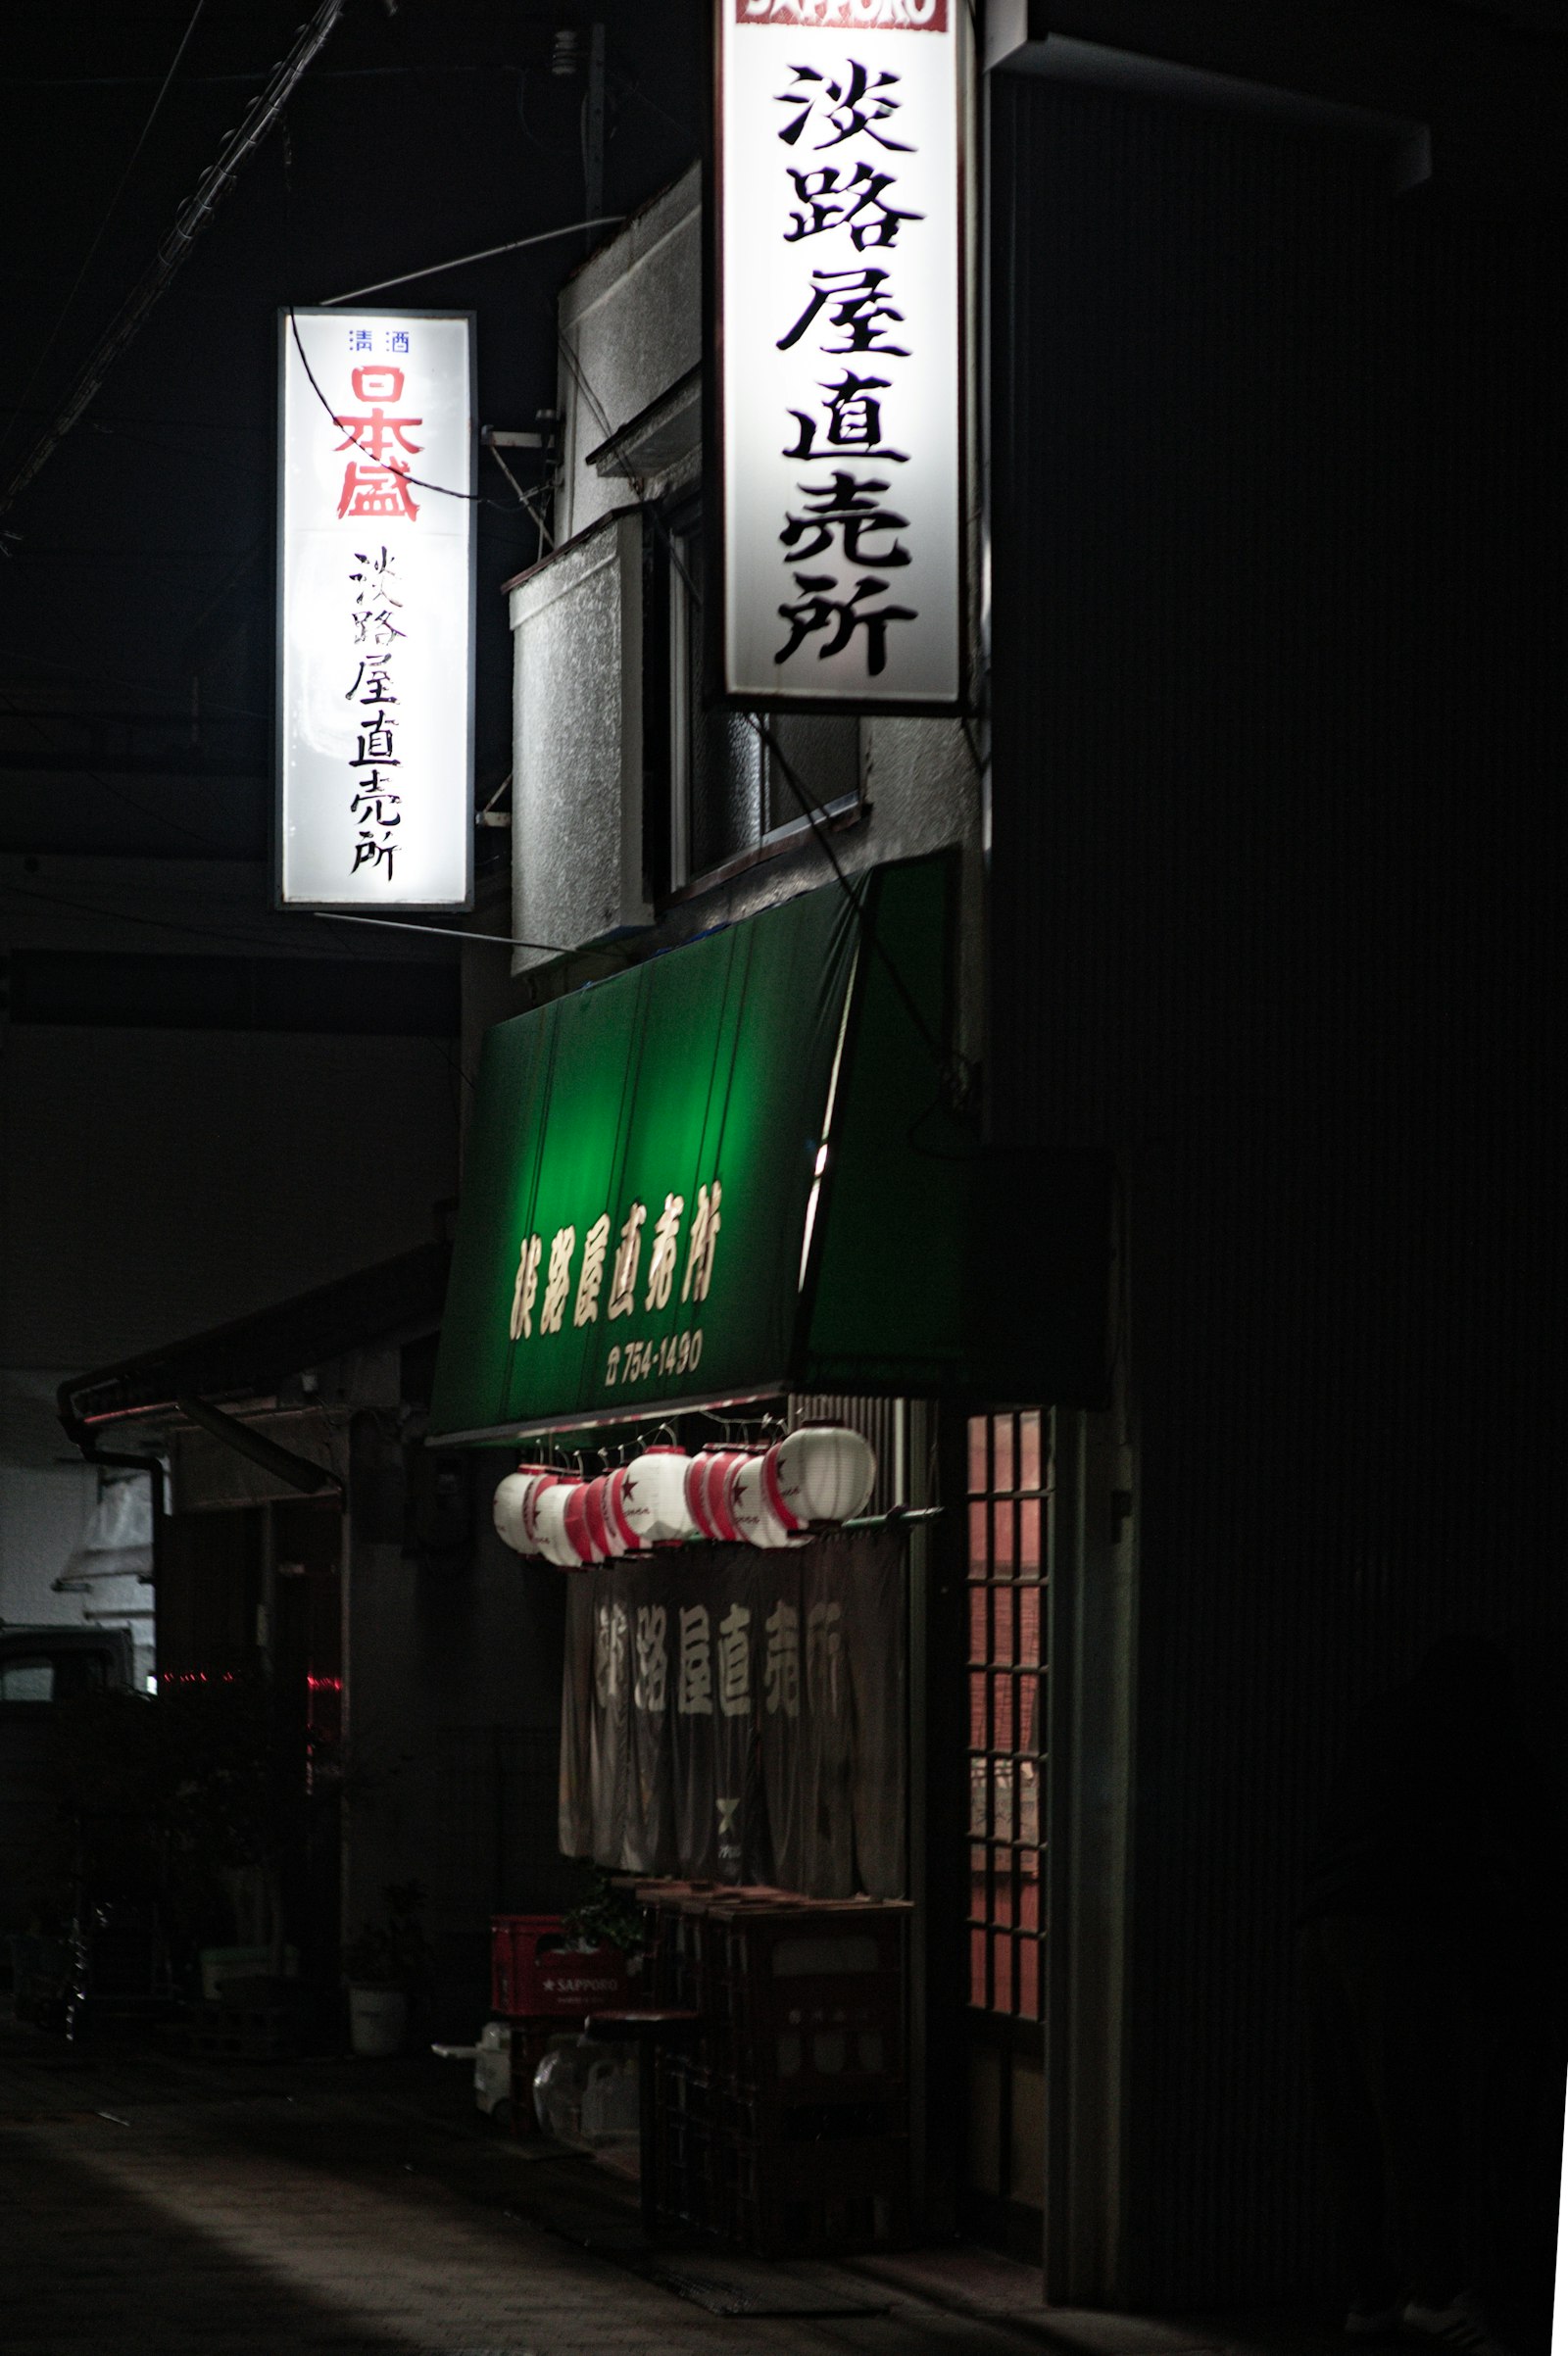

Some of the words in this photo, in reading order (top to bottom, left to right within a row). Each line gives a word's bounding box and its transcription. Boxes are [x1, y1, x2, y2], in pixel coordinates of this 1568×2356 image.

[348, 328, 409, 355] 清酒
[773, 59, 926, 677] 淡路屋直売所
[333, 366, 422, 521] 日本盛
[345, 545, 408, 882] 淡路屋直売所
[621, 1328, 704, 1384] 754-1490
